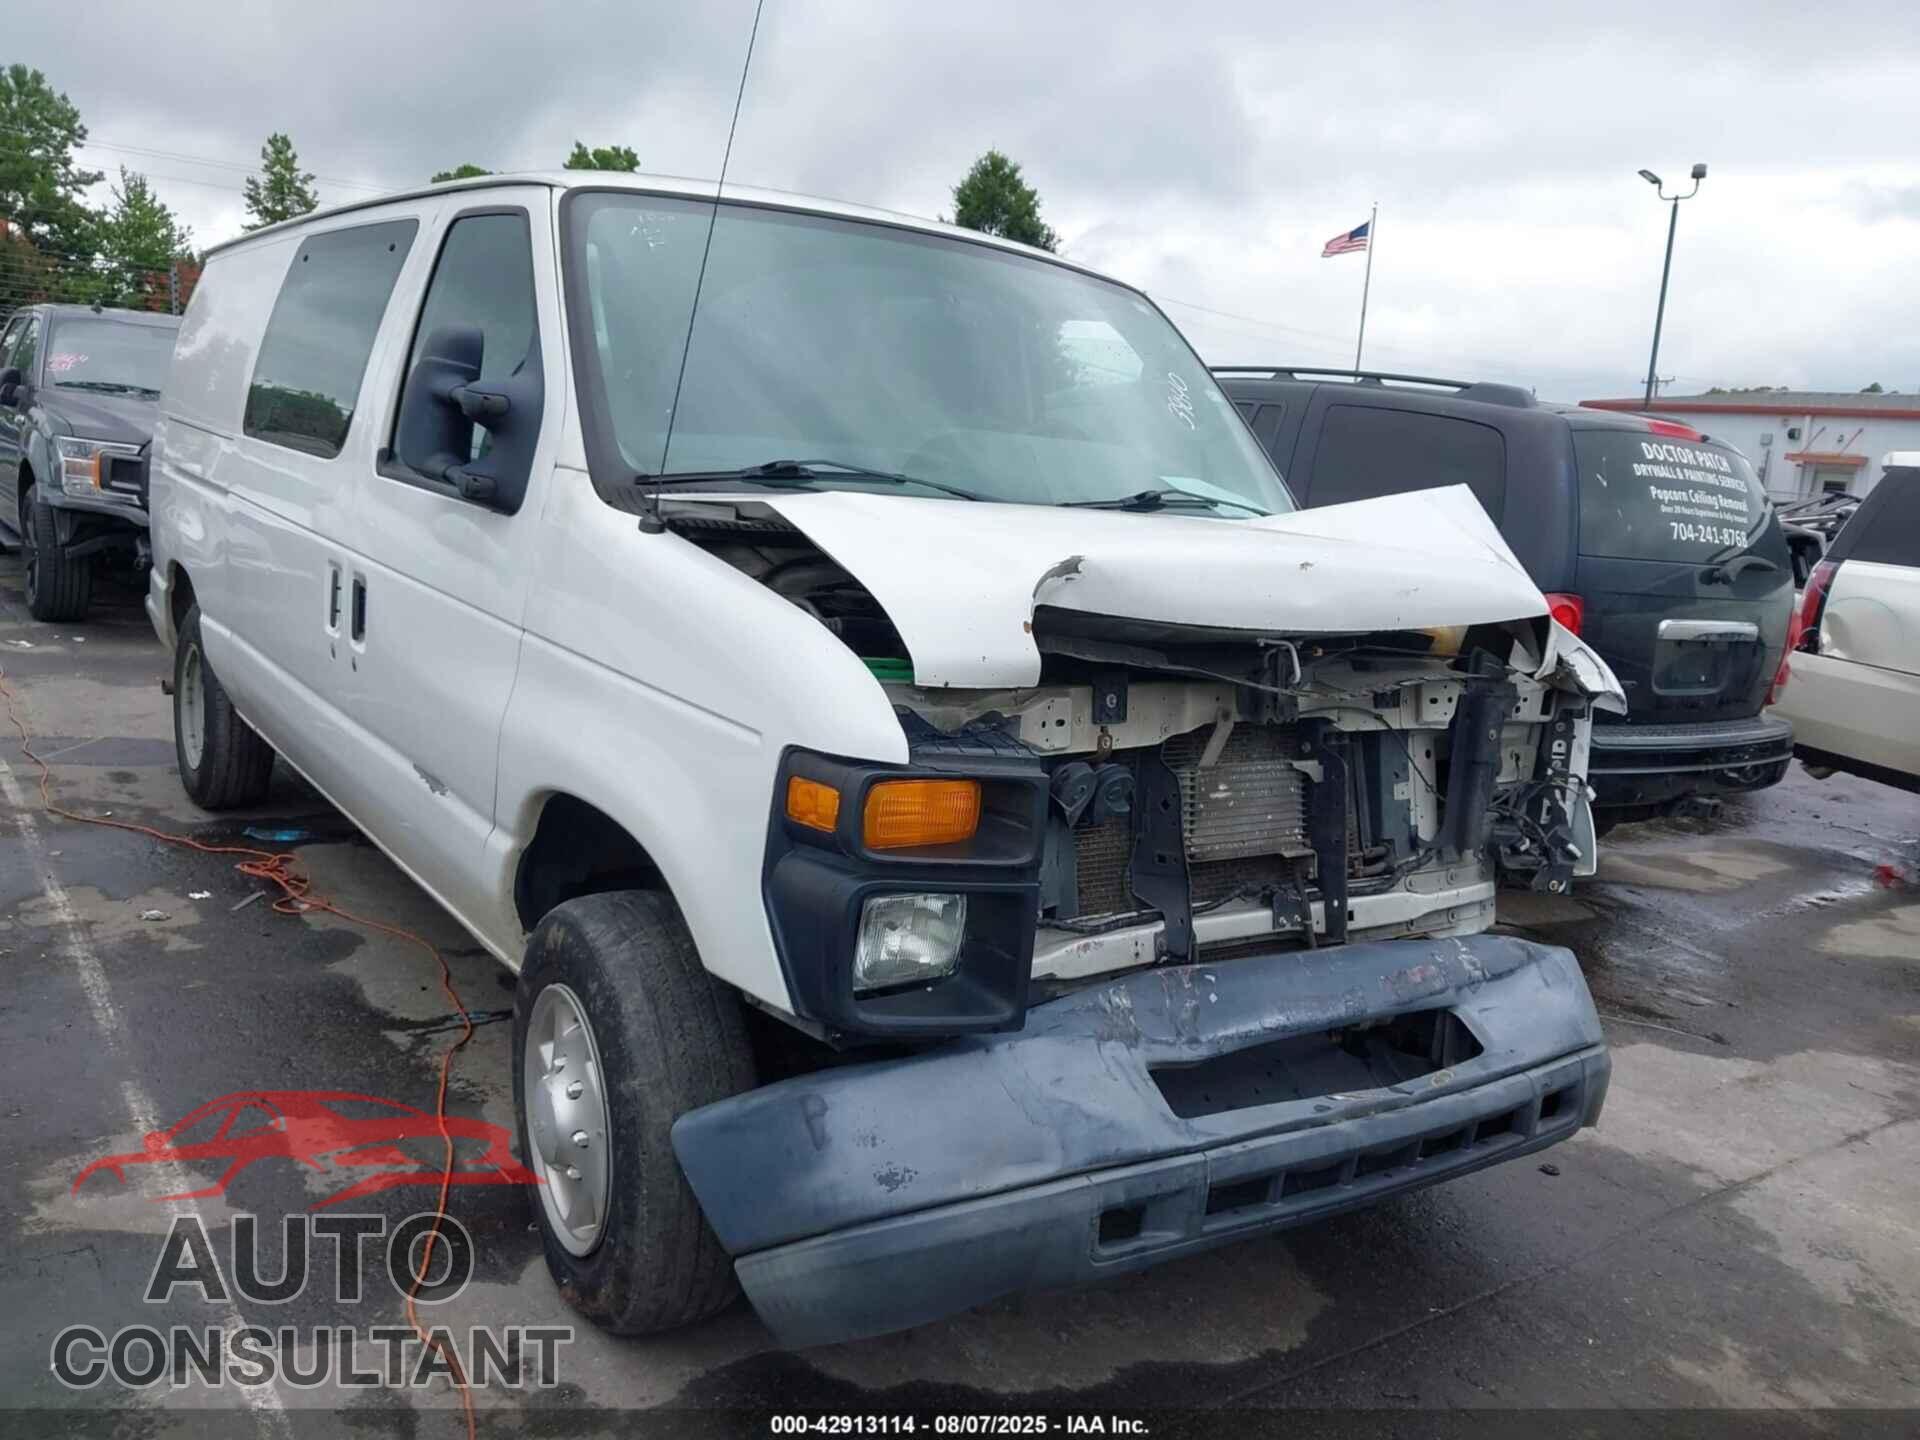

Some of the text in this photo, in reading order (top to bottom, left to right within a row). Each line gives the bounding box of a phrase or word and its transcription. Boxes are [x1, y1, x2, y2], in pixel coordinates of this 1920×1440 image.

[1641, 442, 1732, 473] DOCTOR PATCH
[1632, 463, 1677, 479] DRYWALL
[1683, 468, 1720, 486] PAINTING
[1650, 486, 1749, 512] Popcorn Ceiling Removal
[1669, 522, 1749, 548] 704-241-8768
